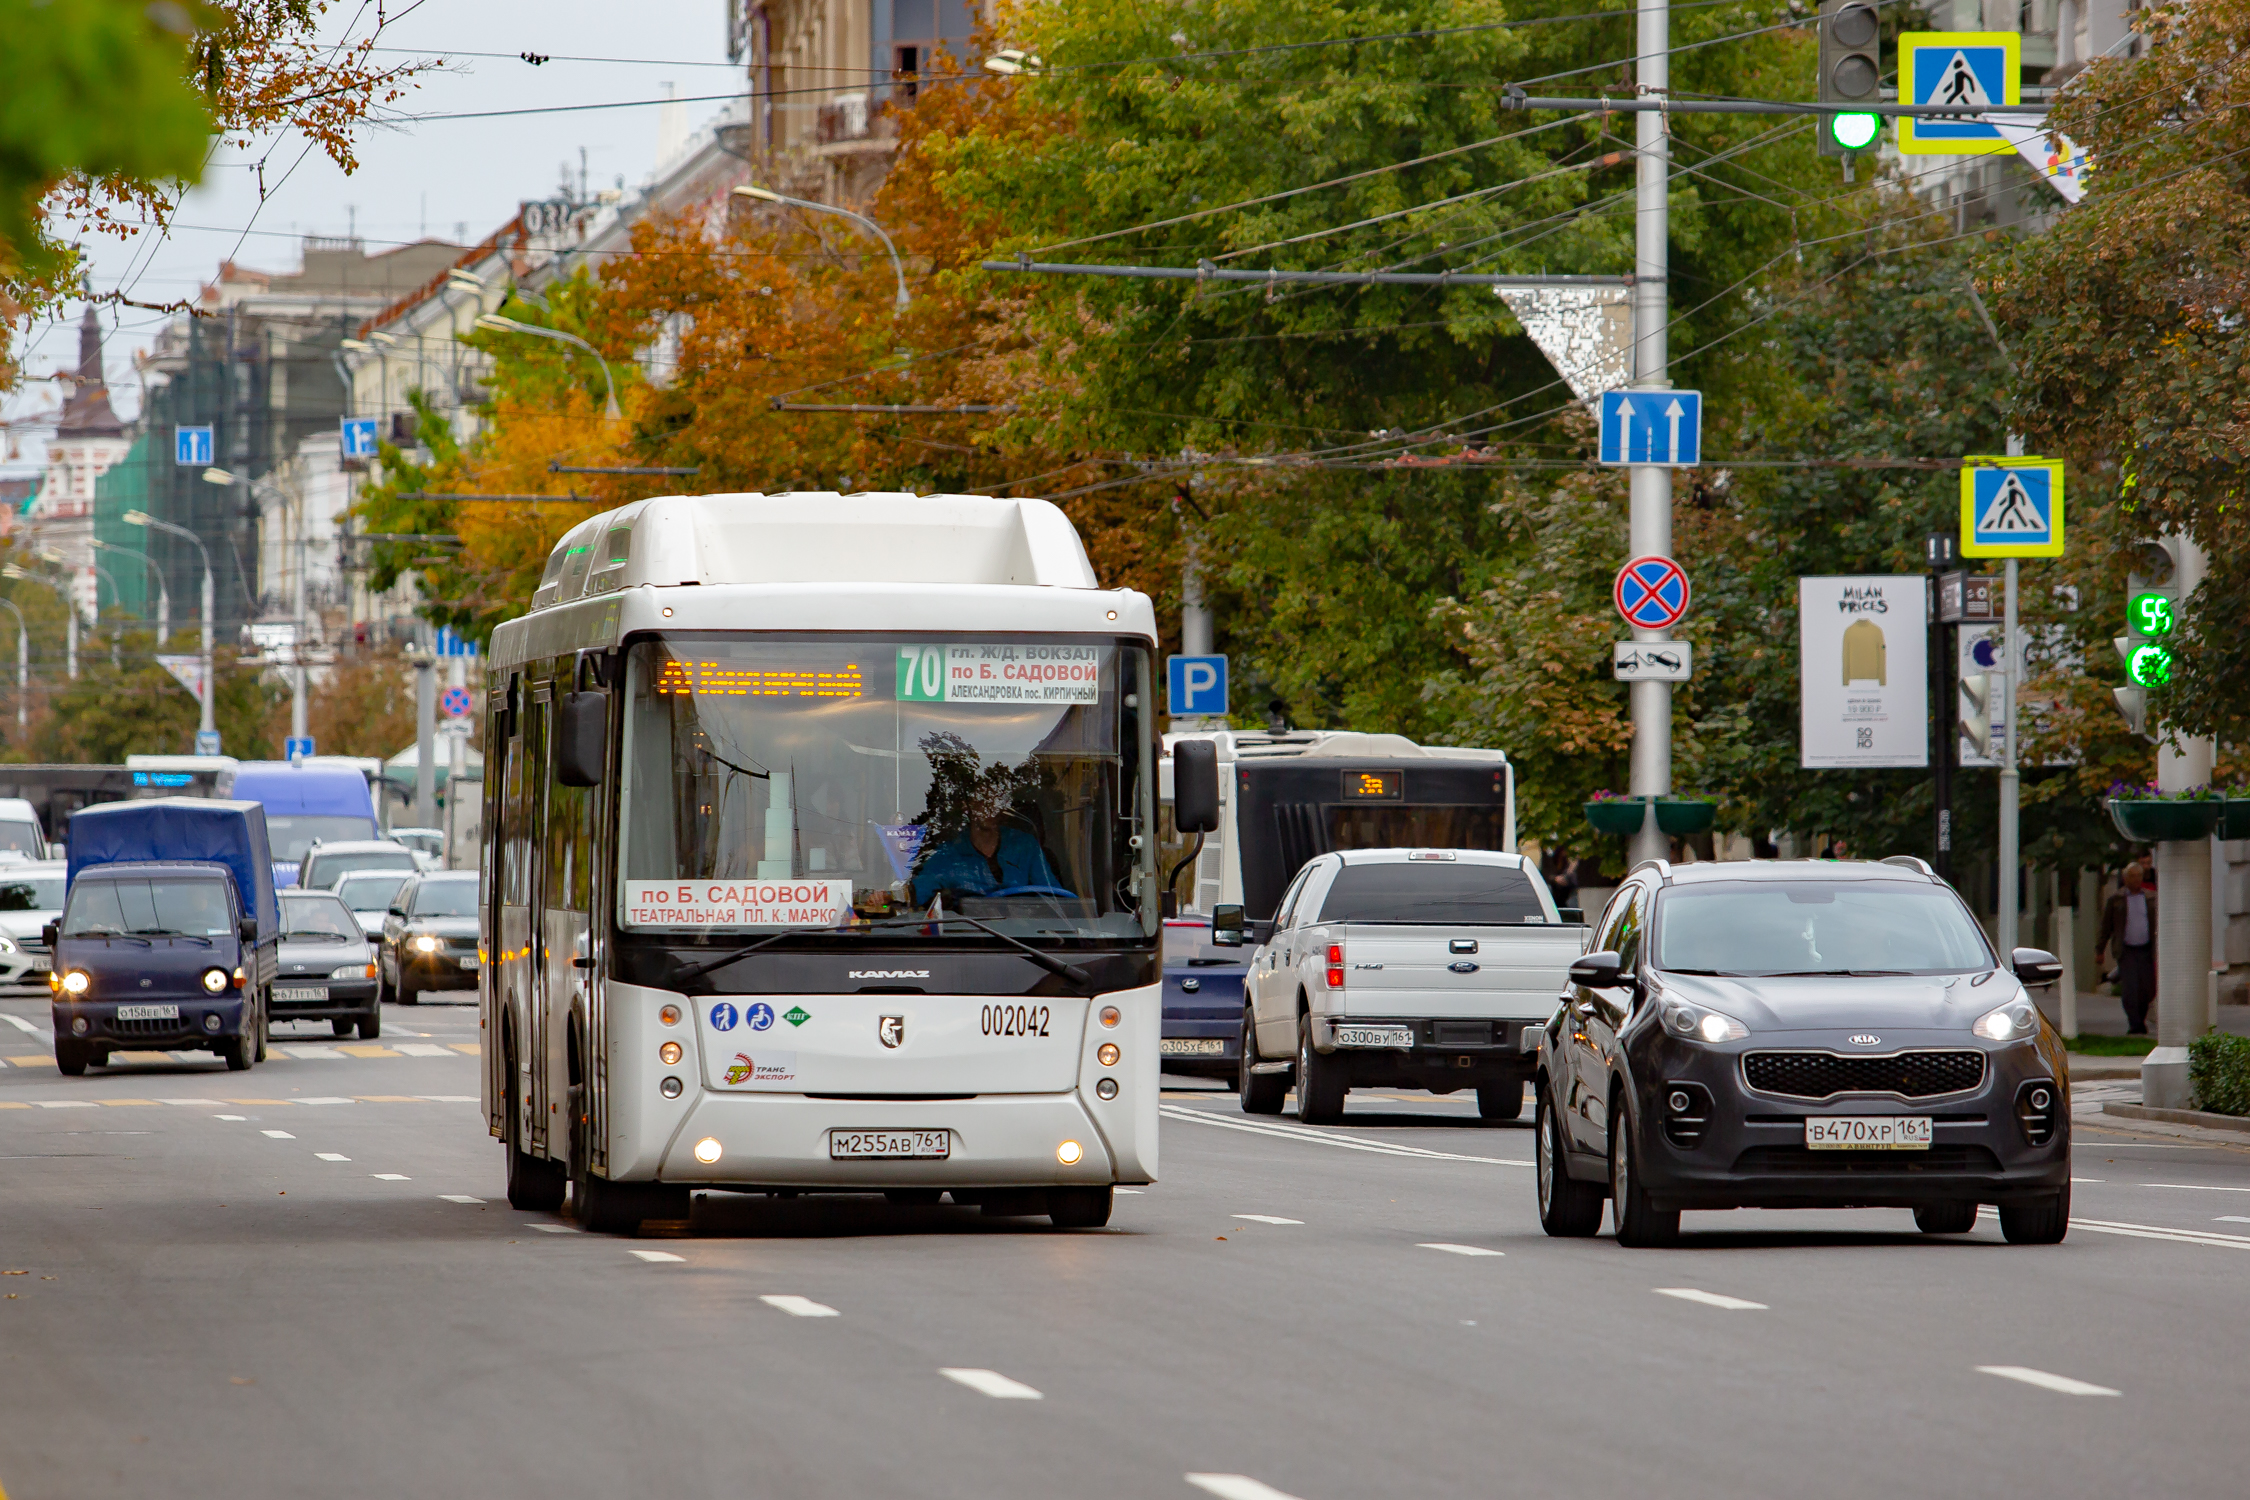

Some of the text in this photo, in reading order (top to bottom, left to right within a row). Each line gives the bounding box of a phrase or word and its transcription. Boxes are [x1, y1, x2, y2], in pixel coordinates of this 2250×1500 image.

[1843, 586, 1883, 600] MILAN
[1838, 600, 1889, 614] PRICES
[951, 645, 1096, 661] гл. Ж/Д. ВОКЗАЛ
[901, 645, 941, 697] 70
[951, 662, 1097, 683] по Б. САДОВОЙ
[951, 684, 1097, 700] АЛЕКСАНДРОВКА пос. КИРПИЧНЫЙ
[641, 881, 829, 906] по Б. САДОВОЙ
[630, 908, 736, 923] ТЕАТРАЛЬНАЯ
[744, 908, 767, 923] ПЛ.
[772, 908, 785, 923] К.
[848, 970, 930, 979] KAMAZ
[161, 1005, 177, 1015] 161
[786, 1012, 808, 1020] КПГ
[981, 1004, 1050, 1037] 002042
[1392, 1031, 1411, 1042] 161
[1853, 1034, 1877, 1044] KIA
[1897, 1119, 1927, 1134] 161
[914, 1133, 943, 1147] 761
